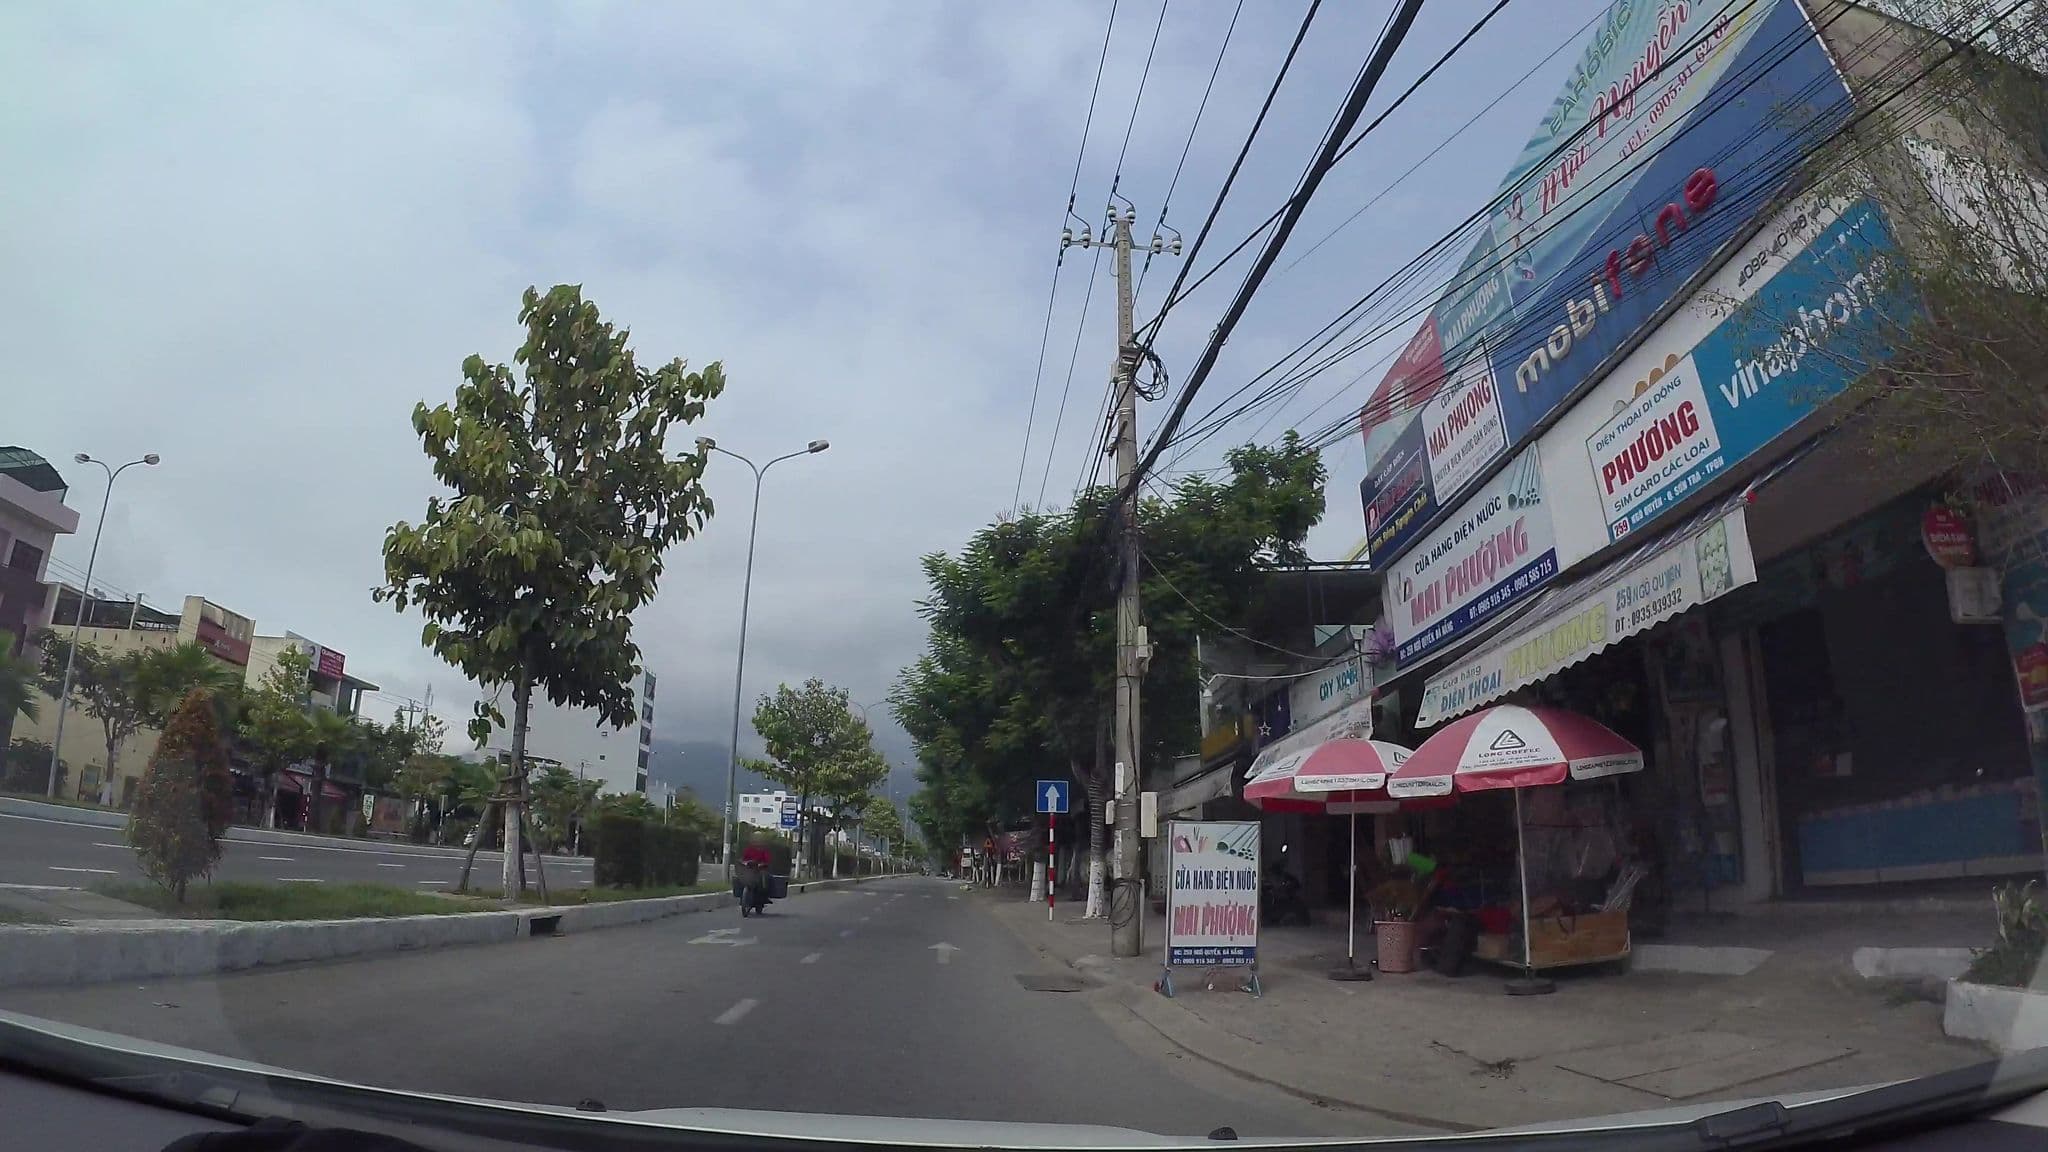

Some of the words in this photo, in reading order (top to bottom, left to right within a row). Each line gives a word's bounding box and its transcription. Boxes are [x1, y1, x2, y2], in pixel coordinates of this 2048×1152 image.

[1515, 167, 1718, 393] mobifone
[1602, 400, 1699, 496] PHƯƠNG
[1614, 492, 1633, 512] SIM
[1633, 472, 1661, 499] CARD
[1614, 519, 1628, 538] 259
[1615, 585, 1632, 612] 259
[1174, 905, 1200, 936] MAI
